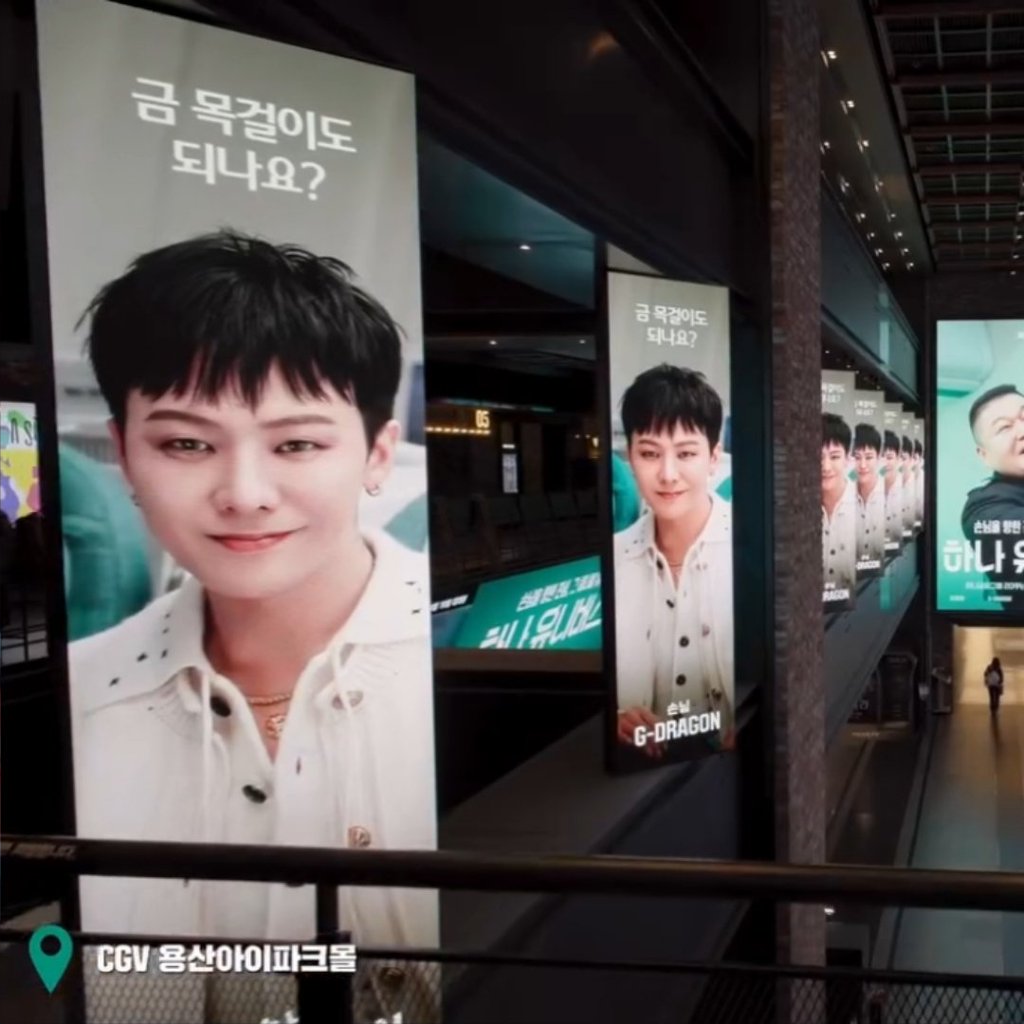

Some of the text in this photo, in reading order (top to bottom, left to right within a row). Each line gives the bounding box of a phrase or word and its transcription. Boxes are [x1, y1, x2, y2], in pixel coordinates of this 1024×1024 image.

[131, 77, 357, 153] 금 목걸이도
[172, 139, 326, 201] 되나요?
[635, 303, 709, 327] 금 목걸이도
[647, 327, 698, 348] 되나요?
[943, 539, 1006, 574] 하나
[634, 710, 721, 747] G-DRAGON
